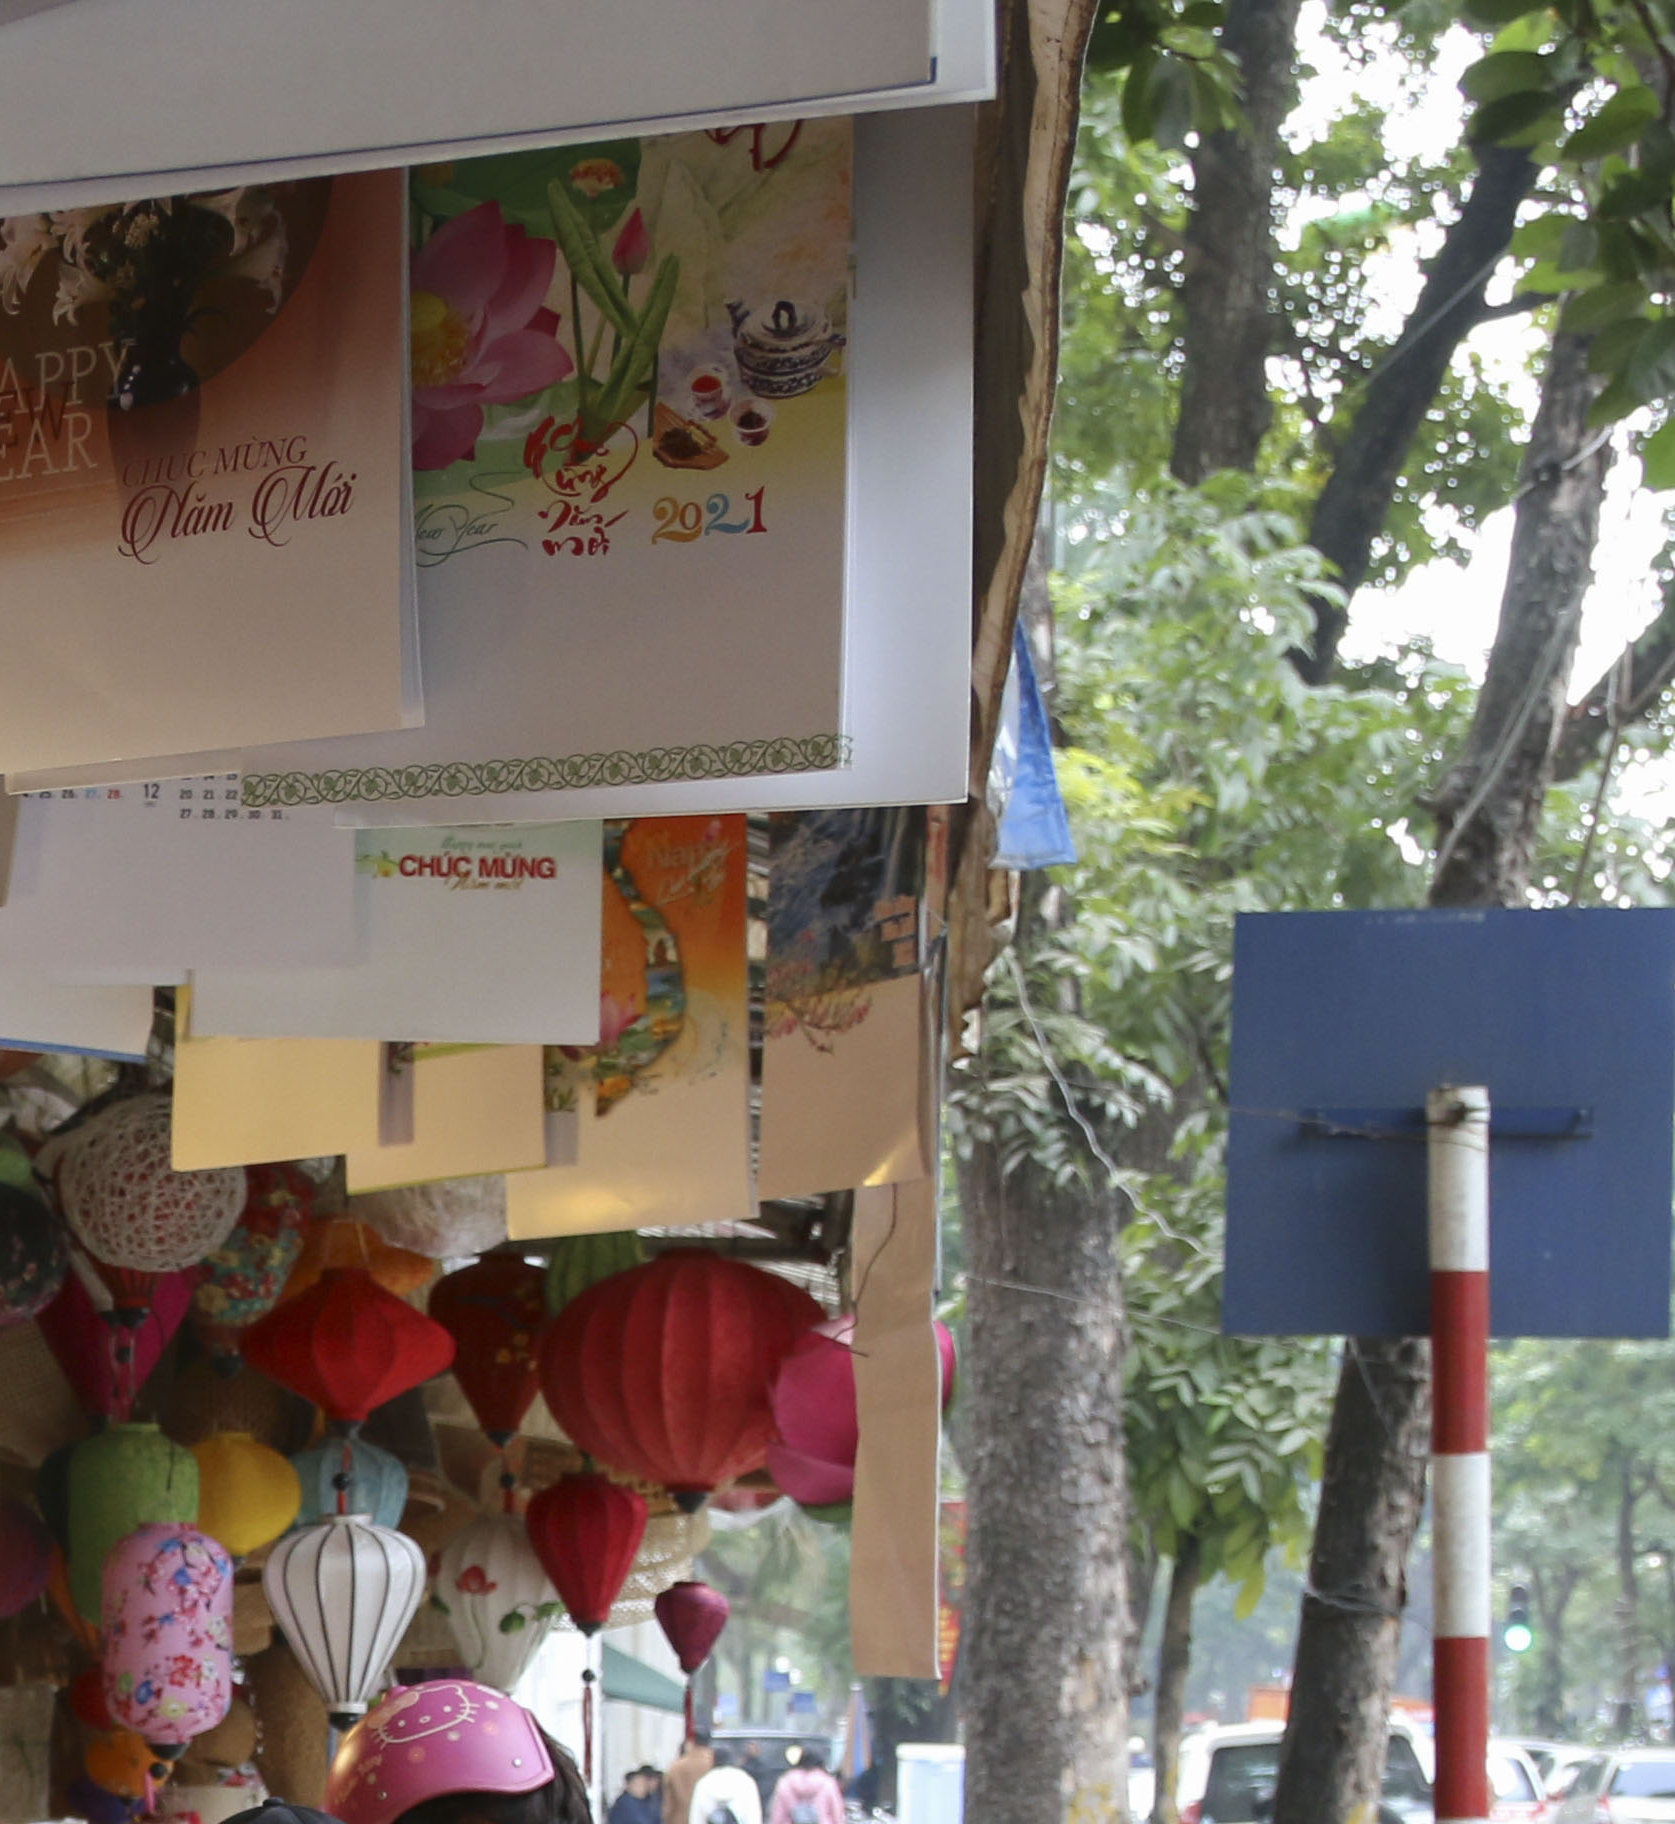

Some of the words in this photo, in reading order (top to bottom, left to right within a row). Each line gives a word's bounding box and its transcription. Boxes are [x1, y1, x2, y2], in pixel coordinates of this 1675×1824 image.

[118, 481, 238, 566] Năm
[248, 458, 357, 548] Mới
[651, 485, 768, 546] 2021
[142, 783, 161, 800] 12
[398, 848, 474, 878] CHÚC
[478, 846, 557, 879] MỪNG
